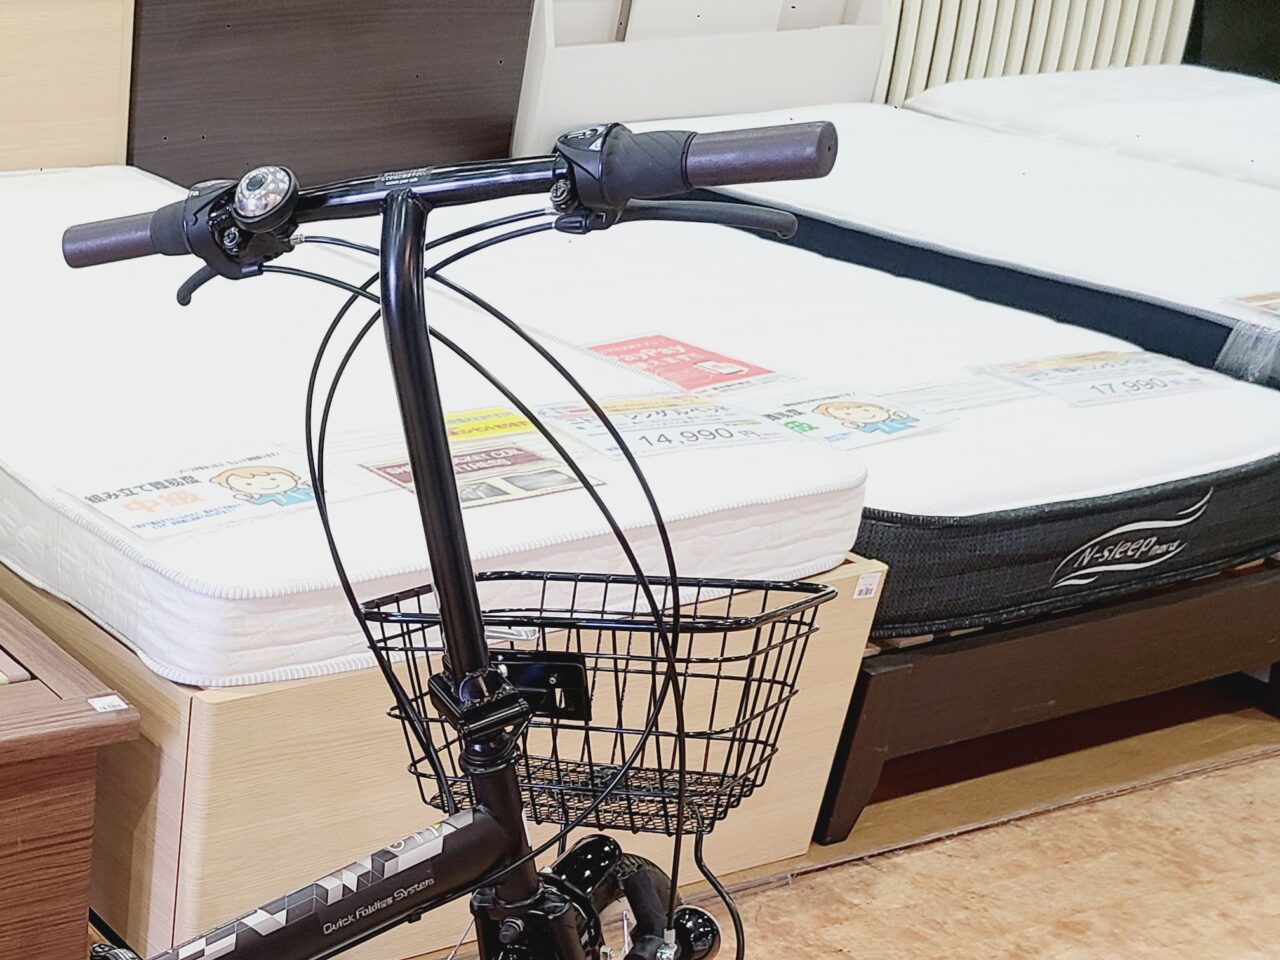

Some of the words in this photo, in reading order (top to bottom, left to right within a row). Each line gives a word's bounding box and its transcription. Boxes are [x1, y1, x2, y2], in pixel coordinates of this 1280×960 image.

[639, 426, 734, 447] 14,990
[1073, 536, 1158, 568] N-sleep
[322, 913, 357, 936] Quick
[394, 877, 436, 902] System
